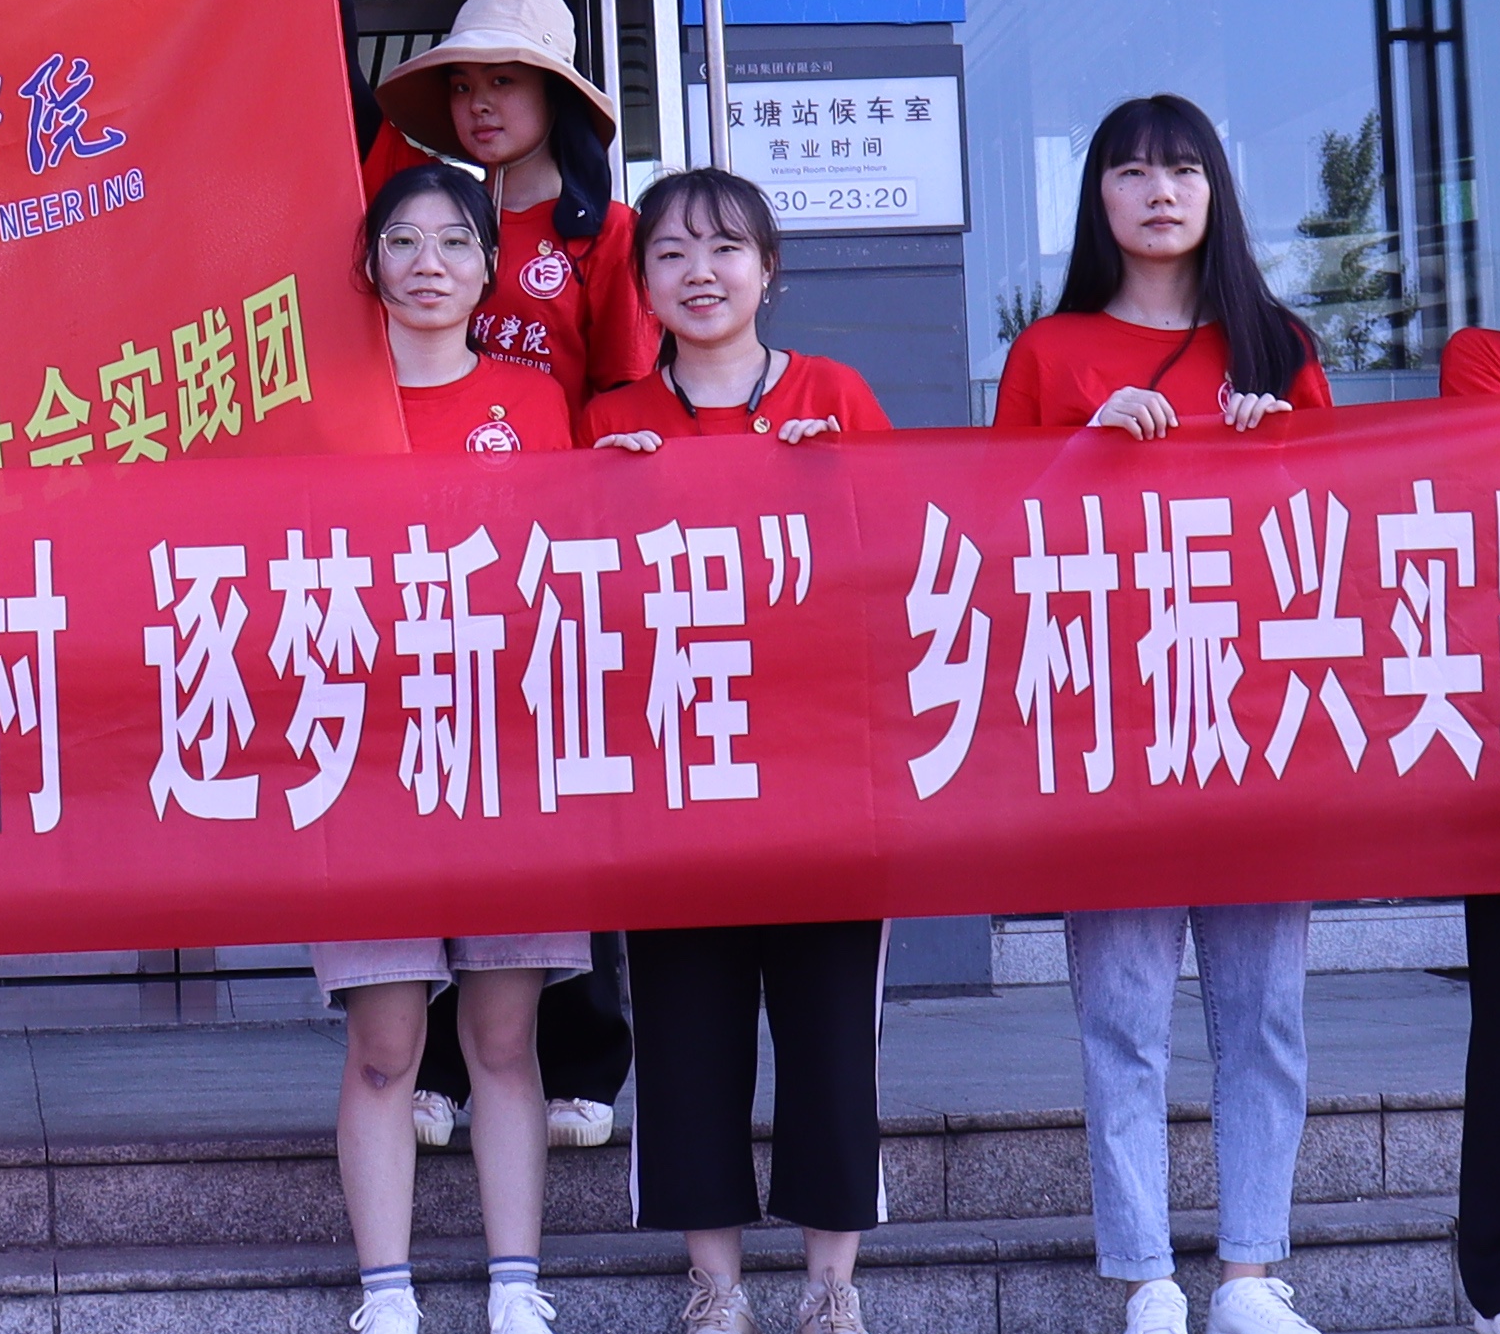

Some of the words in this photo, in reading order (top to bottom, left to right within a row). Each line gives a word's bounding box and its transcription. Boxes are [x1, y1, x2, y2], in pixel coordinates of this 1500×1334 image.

[768, 136, 883, 161] 营业时间
[803, 166, 827, 174] Room
[863, 164, 888, 172] Hours
